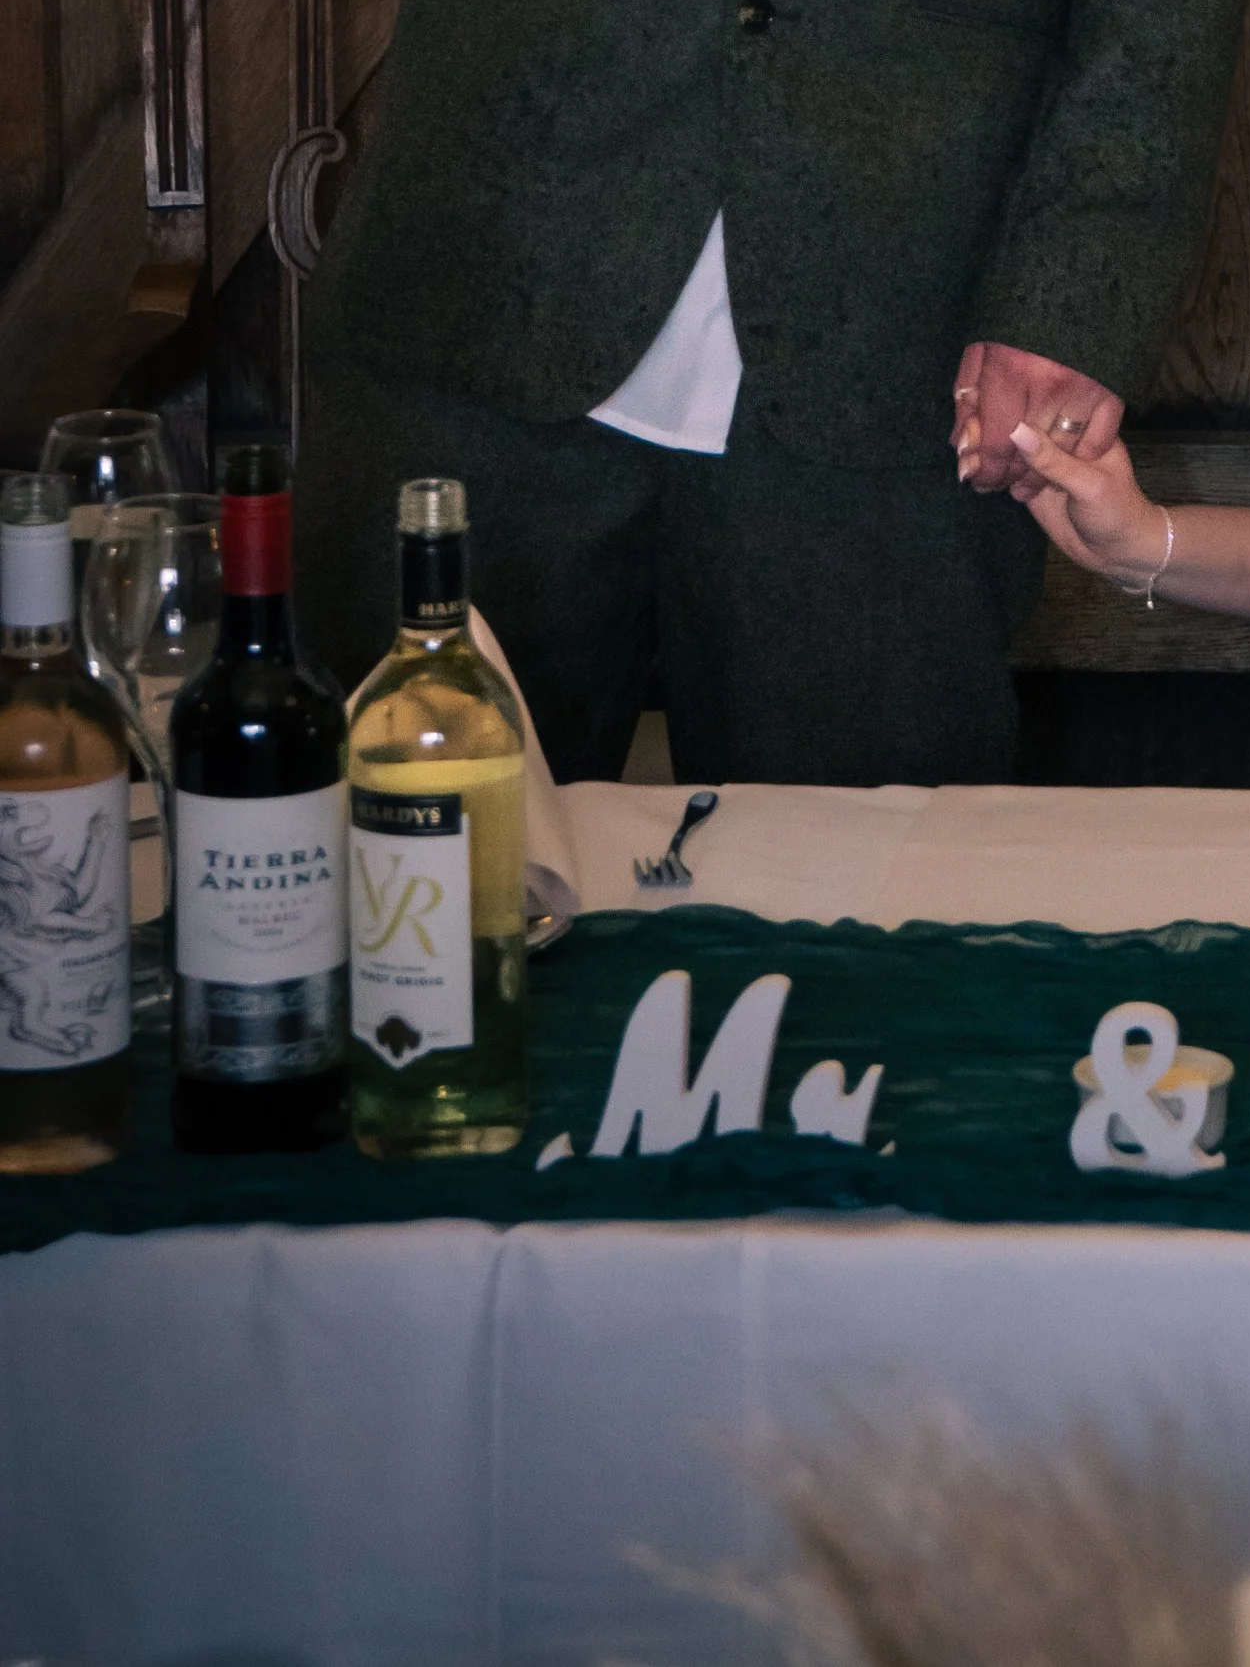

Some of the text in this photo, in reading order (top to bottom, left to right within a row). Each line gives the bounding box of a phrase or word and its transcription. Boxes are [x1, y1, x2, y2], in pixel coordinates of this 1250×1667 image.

[356, 800, 442, 826] HARDYS
[204, 845, 328, 870] TIERRA
[199, 867, 331, 891] ANDINA
[355, 846, 445, 958] VR
[1070, 1002, 1226, 1177] &
